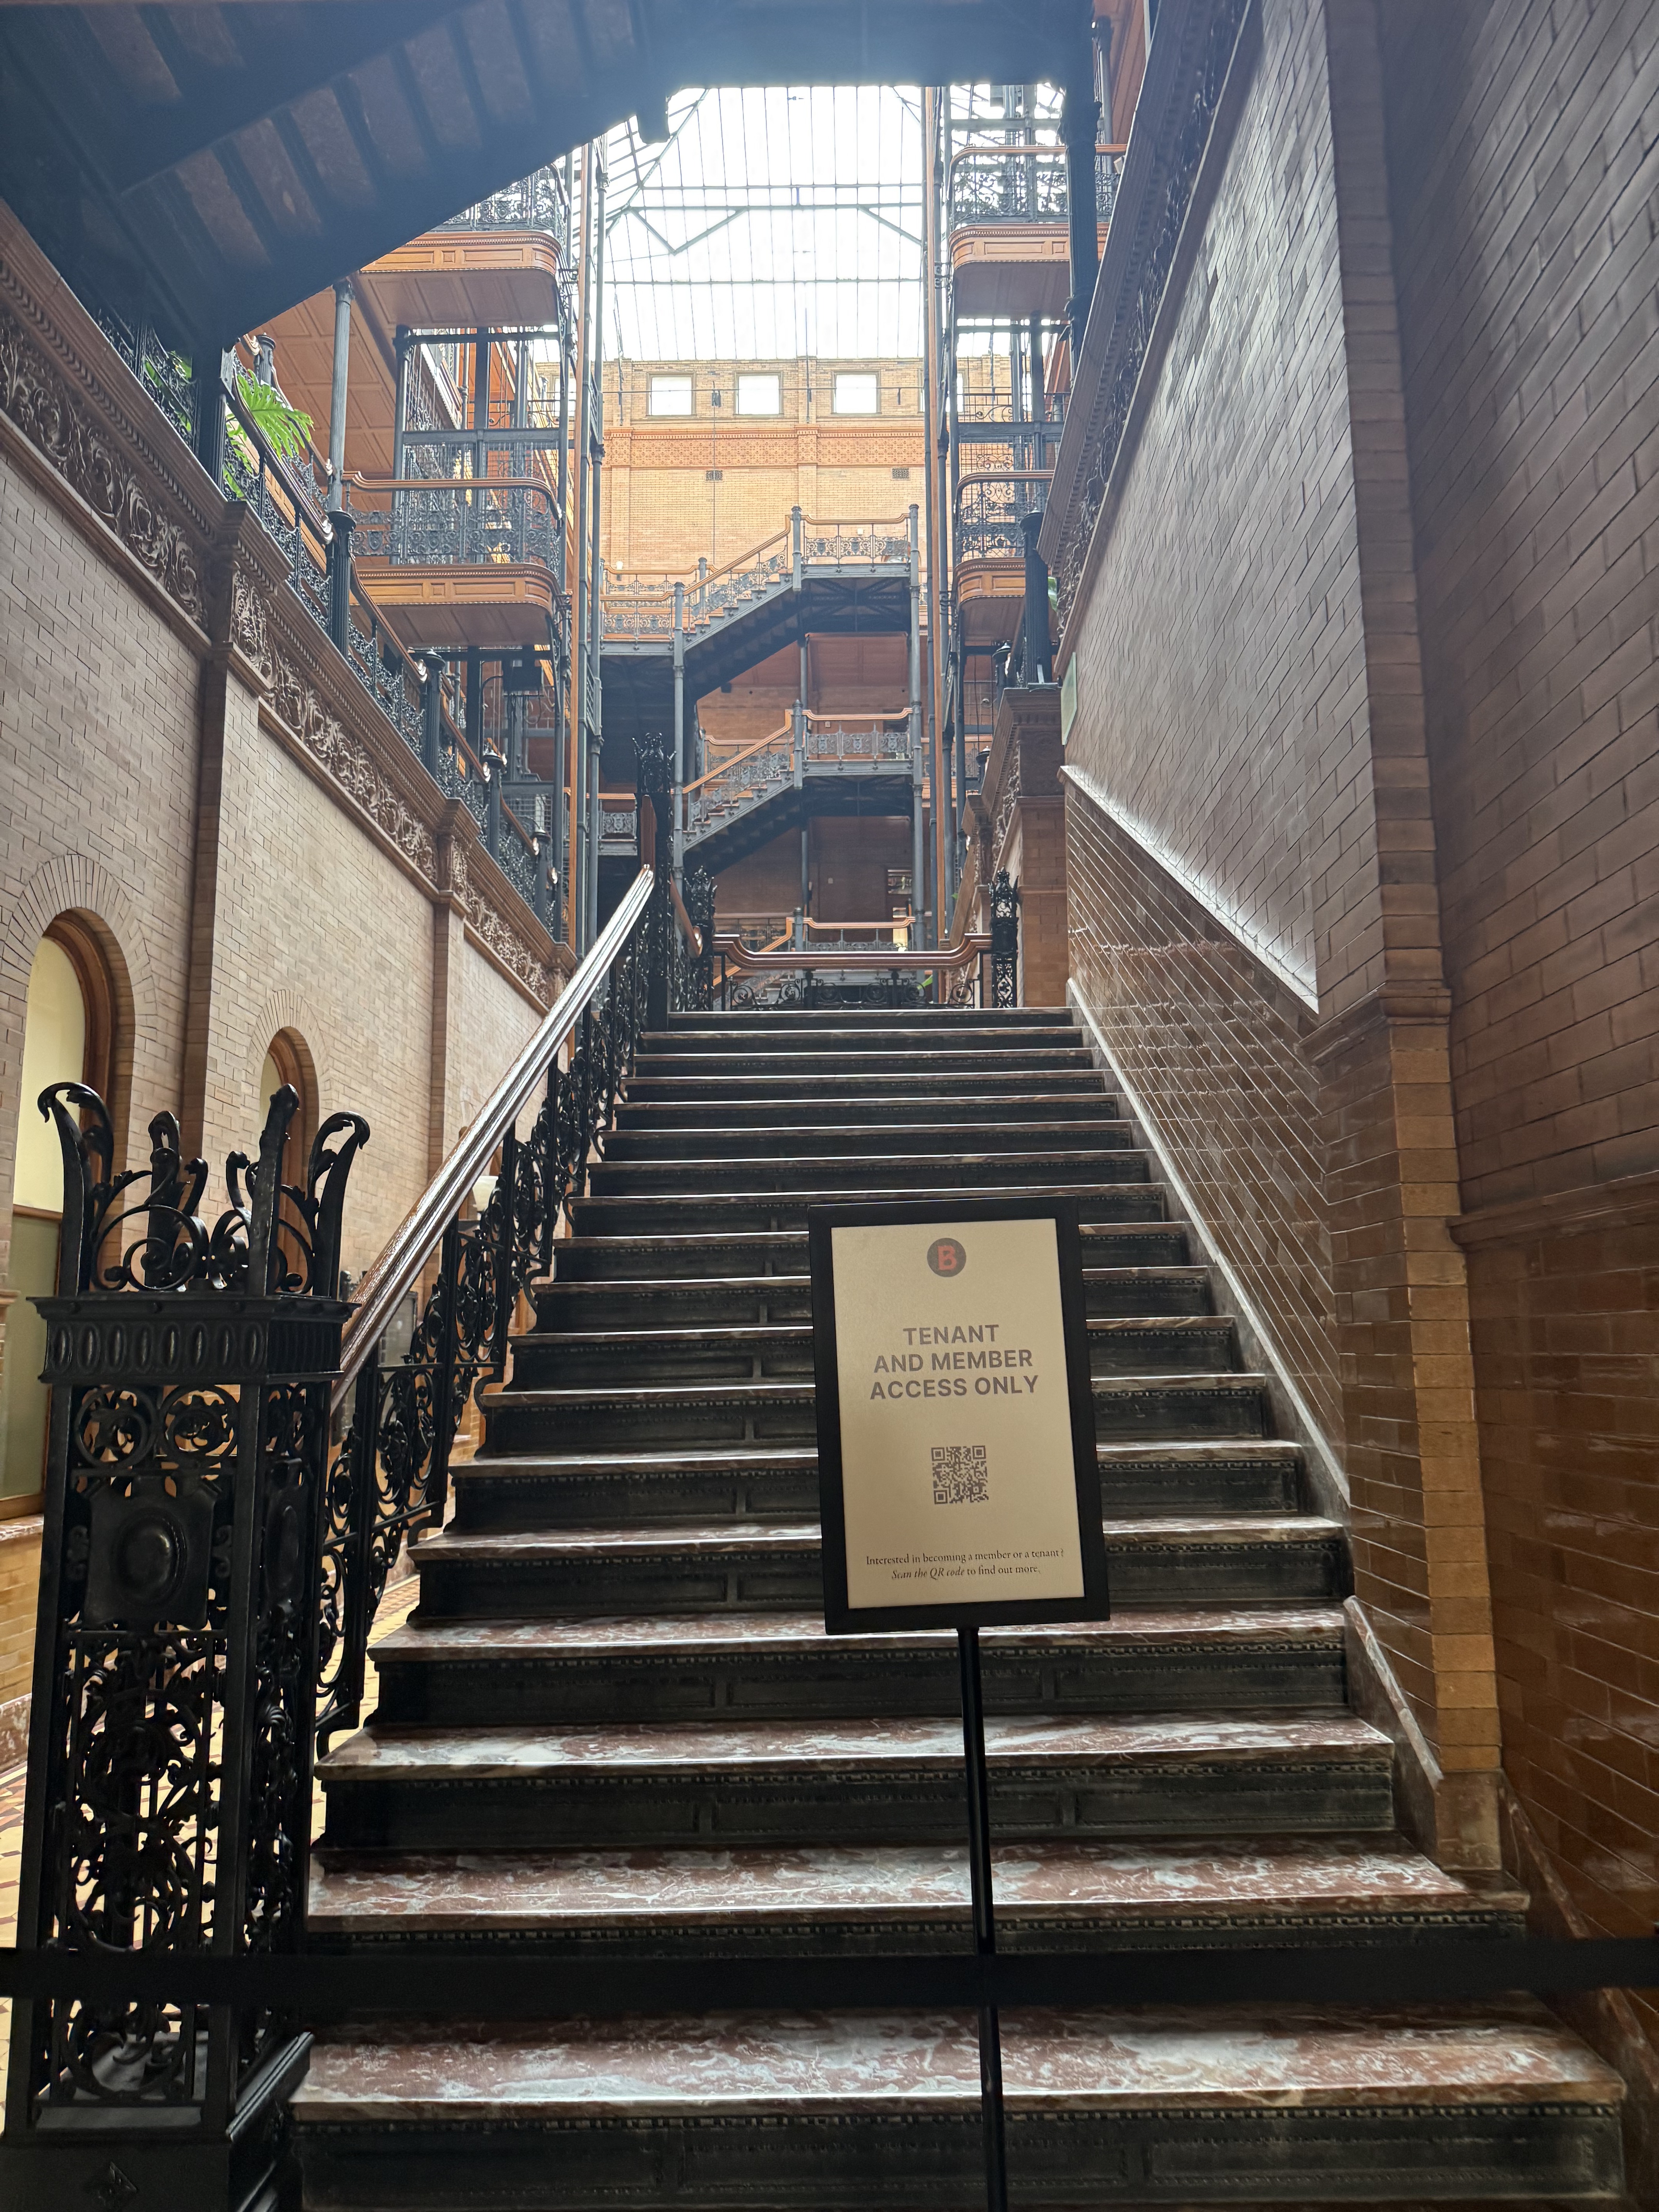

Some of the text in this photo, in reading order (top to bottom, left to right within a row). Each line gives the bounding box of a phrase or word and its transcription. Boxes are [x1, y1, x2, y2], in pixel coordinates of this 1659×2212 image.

[938, 1245, 957, 1270] B
[903, 1324, 999, 1345] TENANT
[874, 1349, 1033, 1373] AND MEMBER
[870, 1375, 1039, 1400] ACCESS ONLY
[867, 1554, 909, 1565] Interested
[912, 1555, 920, 1563] in
[923, 1553, 966, 1563] becoming
[975, 1550, 1011, 1560] member
[1032, 1549, 1063, 1557] tenant?
[892, 1570, 911, 1579] Scan
[914, 1568, 927, 1578] the
[930, 1568, 944, 1580] QR
[947, 1566, 964, 1576] code
[979, 1565, 995, 1575] find
